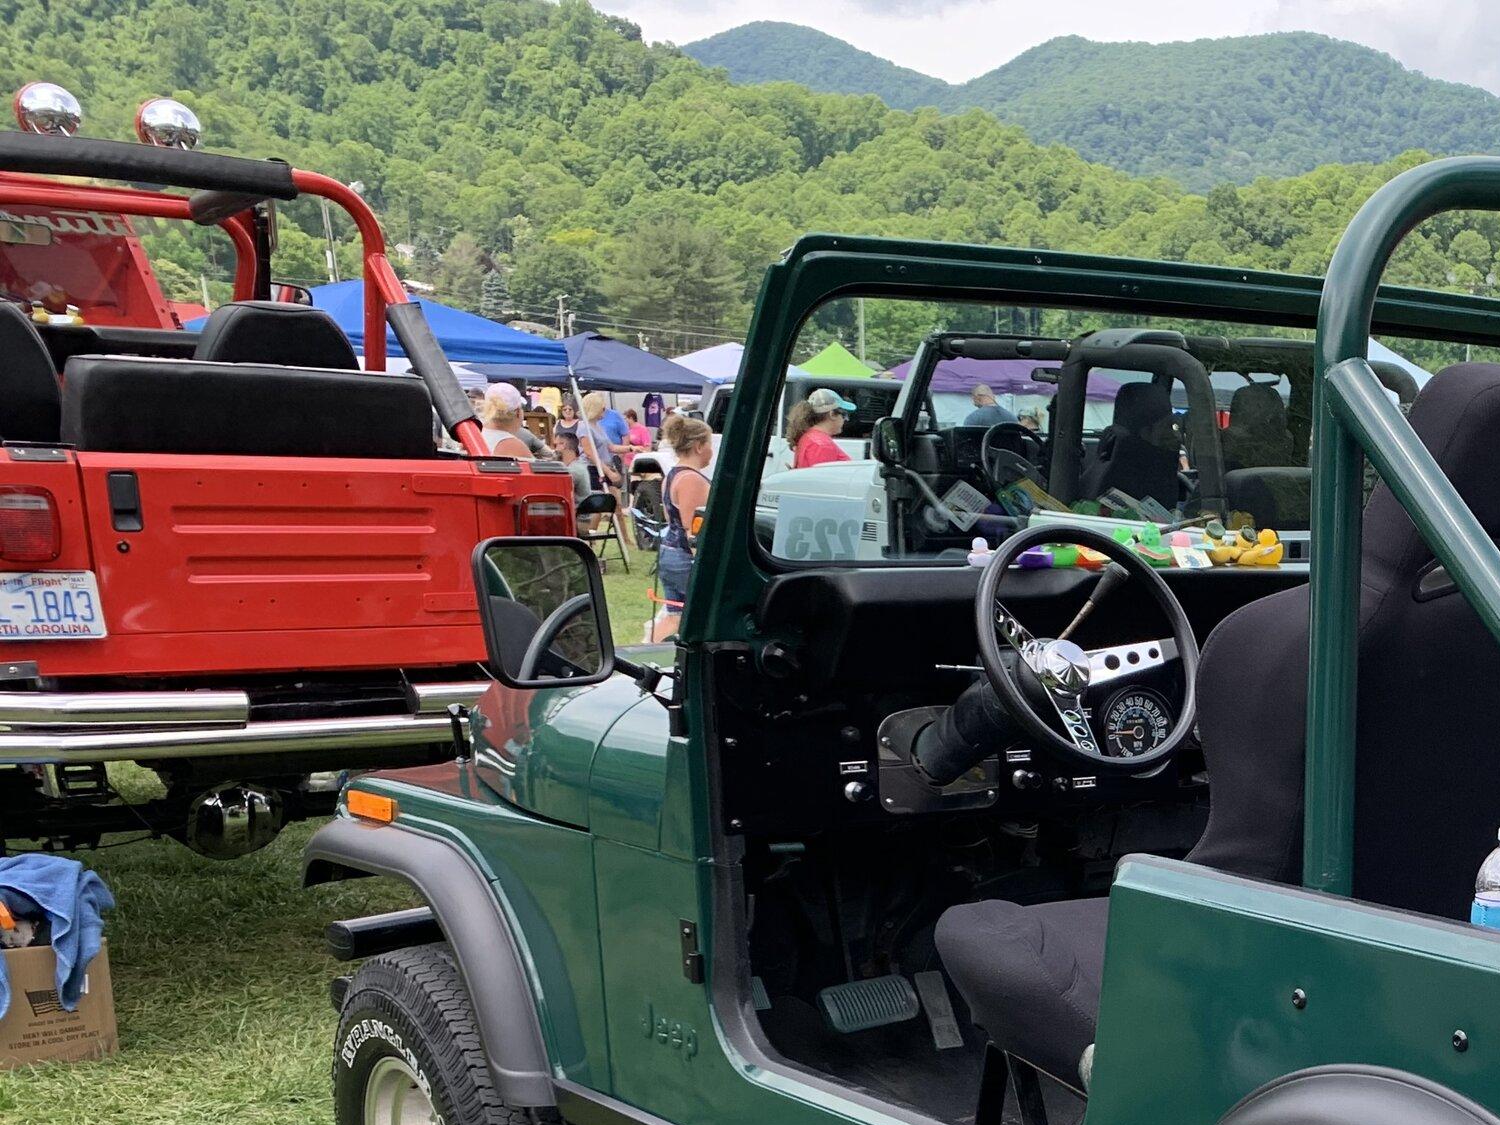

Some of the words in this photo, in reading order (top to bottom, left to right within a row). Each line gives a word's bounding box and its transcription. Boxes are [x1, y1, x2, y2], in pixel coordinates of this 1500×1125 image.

[31, 577, 62, 587] Flight
[25, 624, 91, 634] CAROLINA
[1134, 696, 1143, 706] 50
[1151, 707, 1161, 716] 70
[641, 1003, 698, 1062] Jeep
